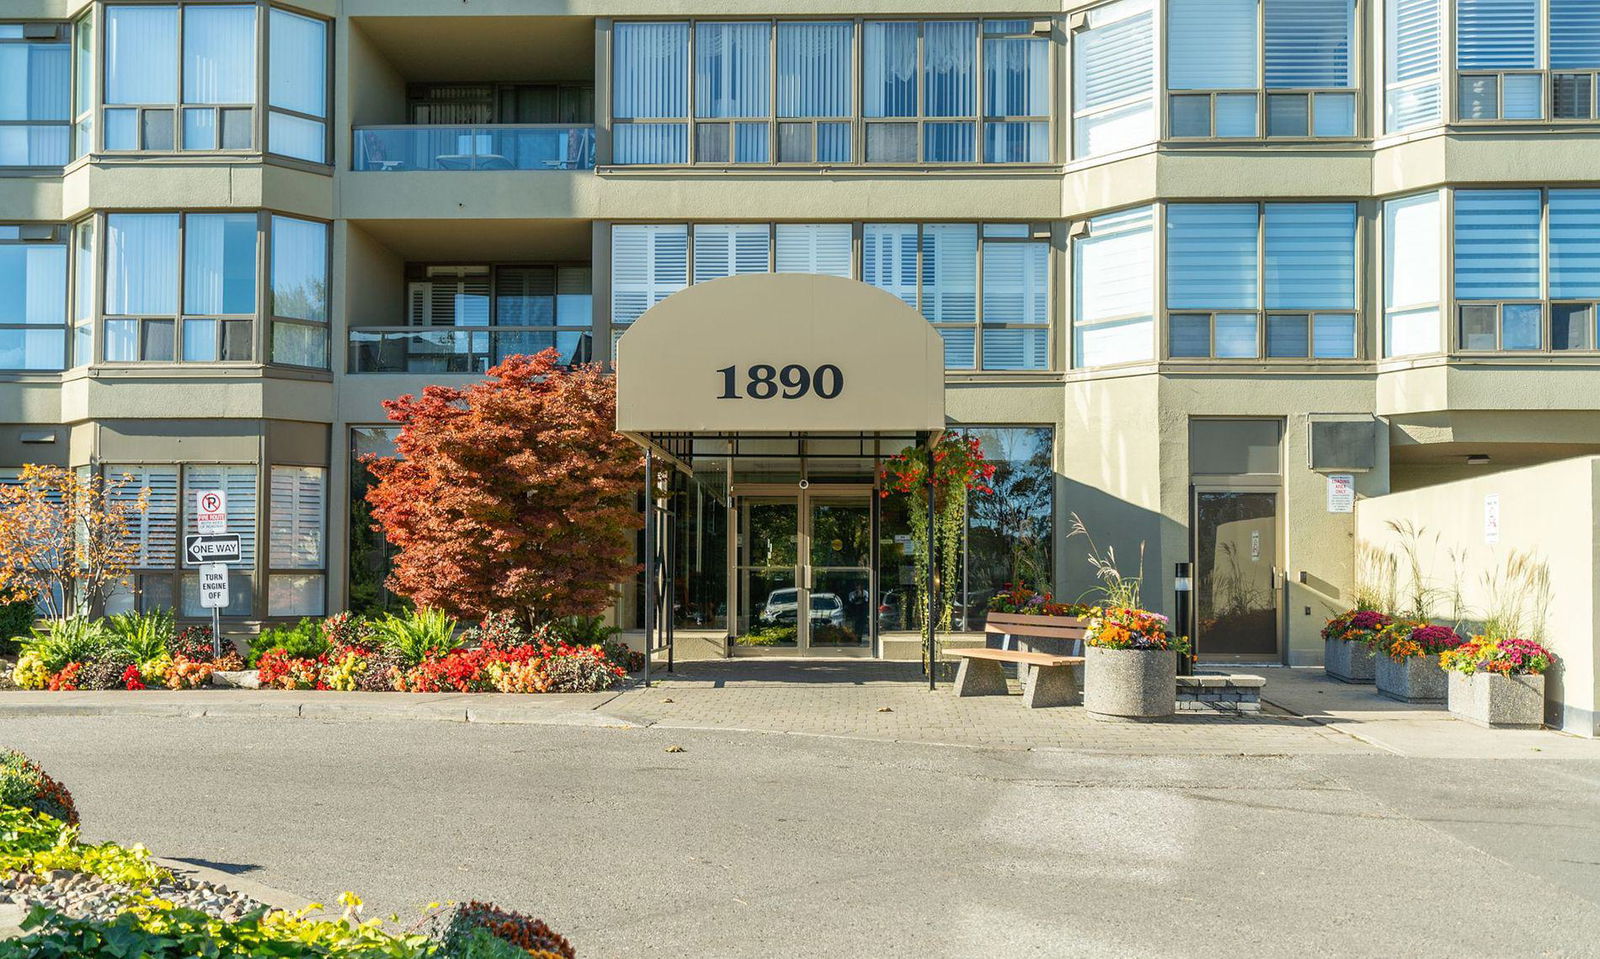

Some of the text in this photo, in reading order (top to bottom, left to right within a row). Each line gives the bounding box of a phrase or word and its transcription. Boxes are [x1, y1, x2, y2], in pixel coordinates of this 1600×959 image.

[716, 364, 844, 399] 1890
[192, 544, 237, 554] ONE WAY
[205, 573, 223, 581] TURN
[202, 582, 226, 590] ENGINE
